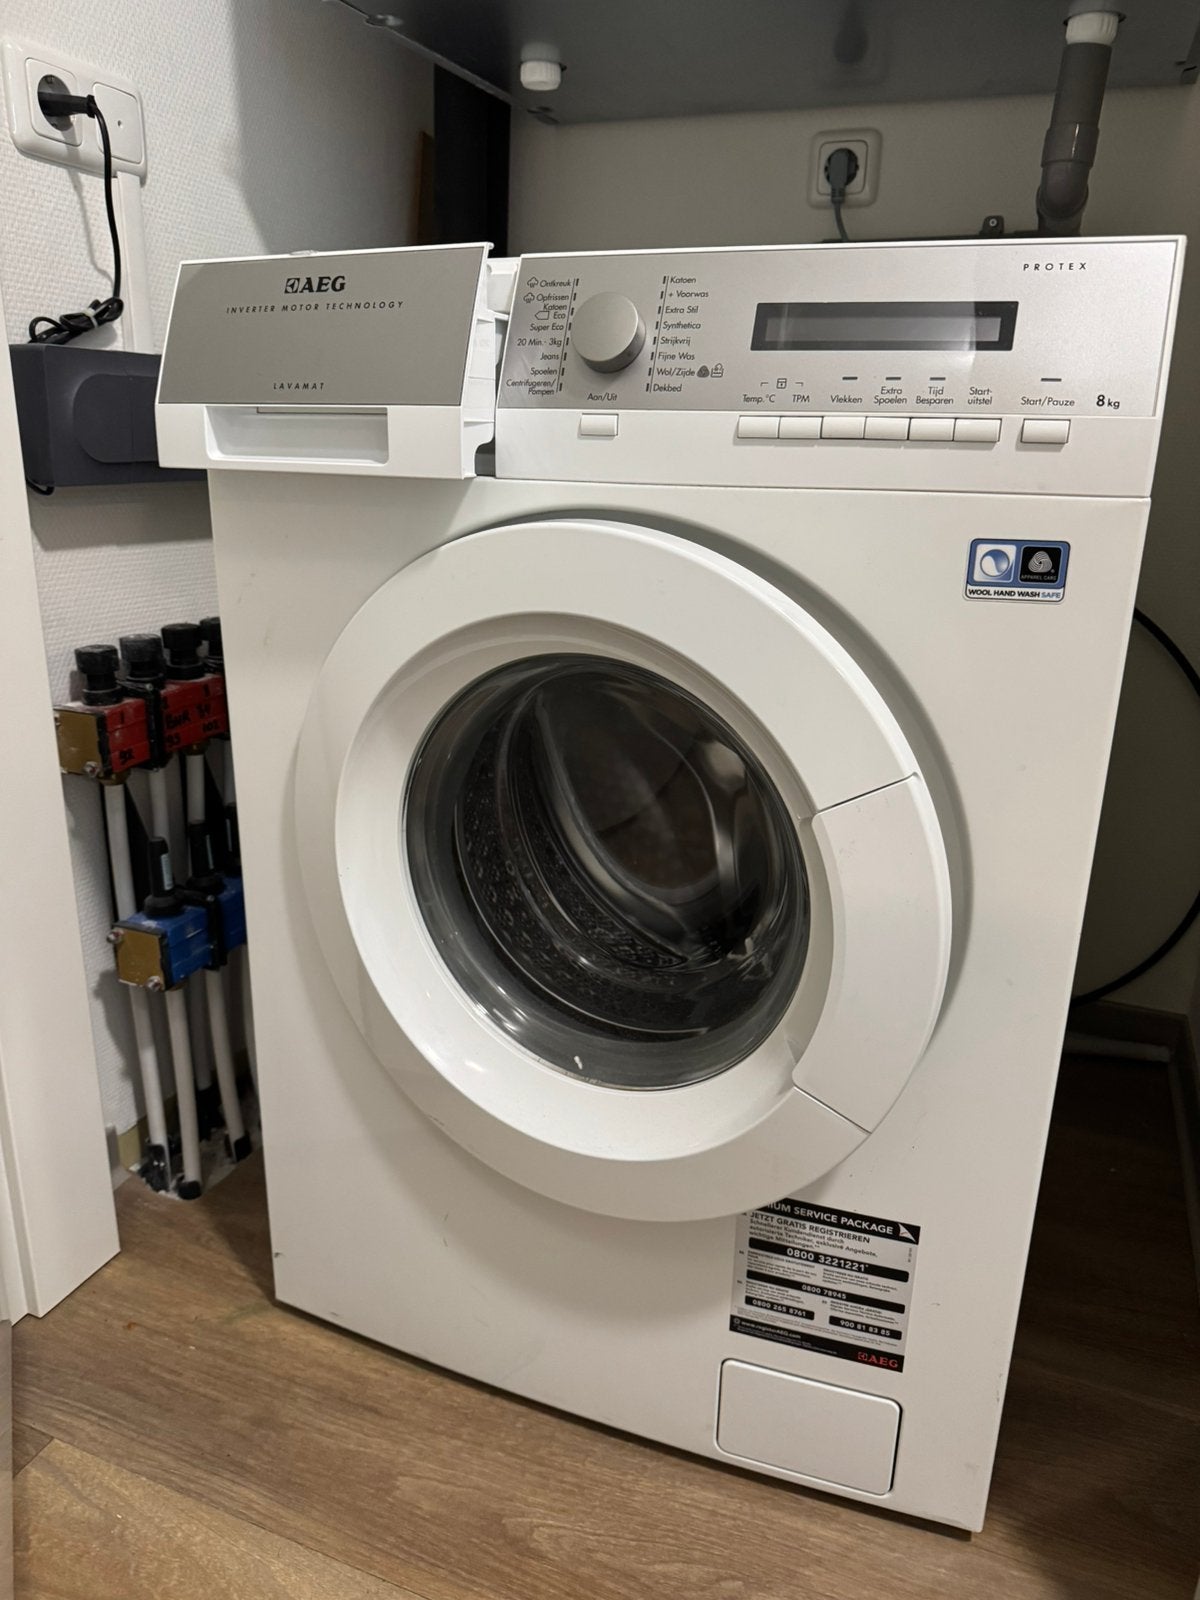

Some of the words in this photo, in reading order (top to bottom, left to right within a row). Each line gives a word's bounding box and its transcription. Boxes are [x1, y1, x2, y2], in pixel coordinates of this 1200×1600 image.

[1023, 263, 1088, 272] PROTEX
[300, 276, 346, 293] AEG
[540, 278, 572, 288] Ontkreuk
[670, 276, 696, 284] Katoen
[536, 292, 570, 302] Opfrissen
[676, 290, 709, 298] Voorwas
[226, 305, 276, 314] INVERTER
[282, 303, 320, 312] MOTOR
[326, 301, 405, 311] TECHNOLOGY
[543, 303, 568, 311] Katoen
[665, 306, 685, 314] Extra
[686, 306, 699, 314] Stil
[529, 324, 550, 332] Super
[551, 323, 564, 331] Eco
[662, 321, 702, 330] Synthetica
[517, 338, 528, 346] 20
[548, 338, 562, 348] 3kg
[660, 336, 691, 346] Strijkvrij
[540, 352, 560, 361] Jeans
[657, 352, 677, 362] Fijne
[678, 352, 696, 360] Was
[530, 368, 558, 376] Spoelen
[656, 368, 696, 377] Wol/Zijde
[273, 382, 326, 391] LAVAMAT
[506, 379, 556, 388] Centrifugeren/
[652, 384, 682, 392] Dekbed
[528, 388, 554, 396] Pompen
[880, 386, 903, 394] Extra
[928, 386, 944, 396] Tijd
[968, 386, 993, 396] Start-
[587, 392, 618, 402] Aan/Uit
[792, 394, 811, 403] TPM
[830, 394, 863, 404] Vlekken
[873, 395, 908, 405] Spoelen
[915, 395, 954, 406] Besparen
[967, 396, 993, 405] uitstel
[1020, 396, 1076, 408] Start/Pauze
[794, 1206, 838, 1222] SERVICE
[840, 1216, 894, 1236] PACKAGE
[750, 1212, 774, 1222] JETZT
[776, 1218, 808, 1230] GRATIS
[809, 1224, 871, 1244] REGISTRIEREN
[786, 1248, 815, 1260] 0800
[802, 1284, 822, 1294] 0800
[824, 1288, 847, 1300] 78945
[752, 1298, 772, 1308] 0800
[773, 1304, 788, 1312] 265
[788, 1307, 806, 1317] 8761
[840, 1319, 855, 1328] 900
[856, 1323, 867, 1332] 81
[880, 1328, 891, 1337] 85
[869, 1354, 898, 1368] AEG
